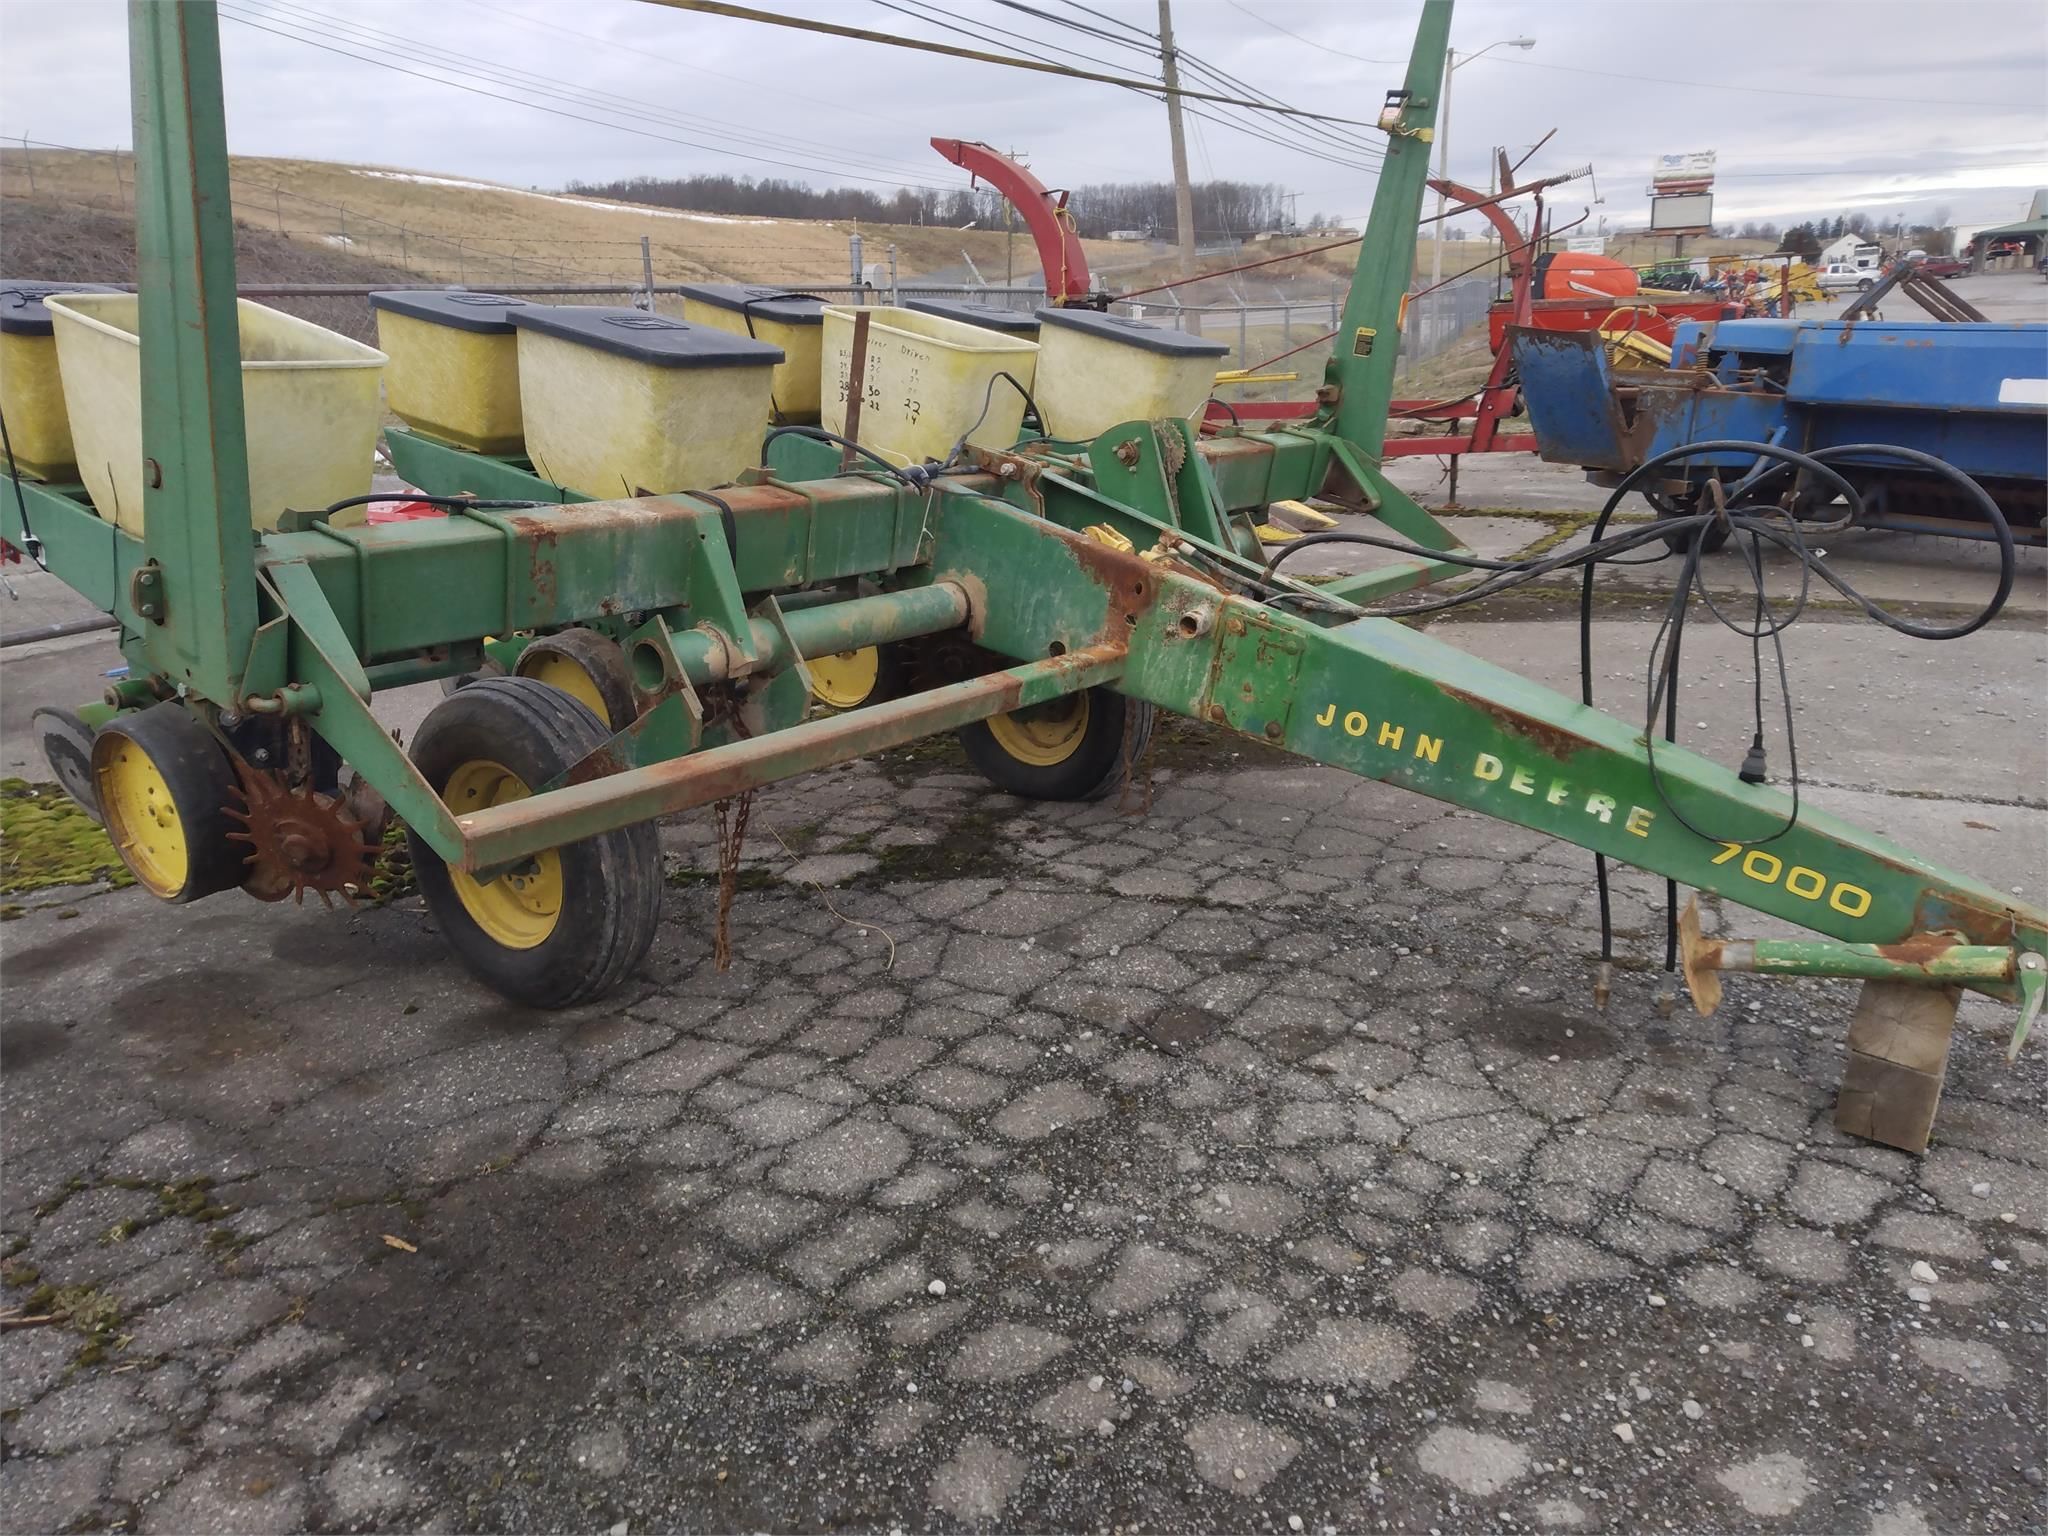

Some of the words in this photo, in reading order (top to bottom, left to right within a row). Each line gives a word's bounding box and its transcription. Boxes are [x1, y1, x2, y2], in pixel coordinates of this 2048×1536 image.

[901, 344, 930, 361] Driven
[904, 398, 921, 416] 22
[1316, 703, 1444, 763] JOHN
[1472, 752, 1657, 838] DEERE
[1710, 840, 1873, 918] 7000
